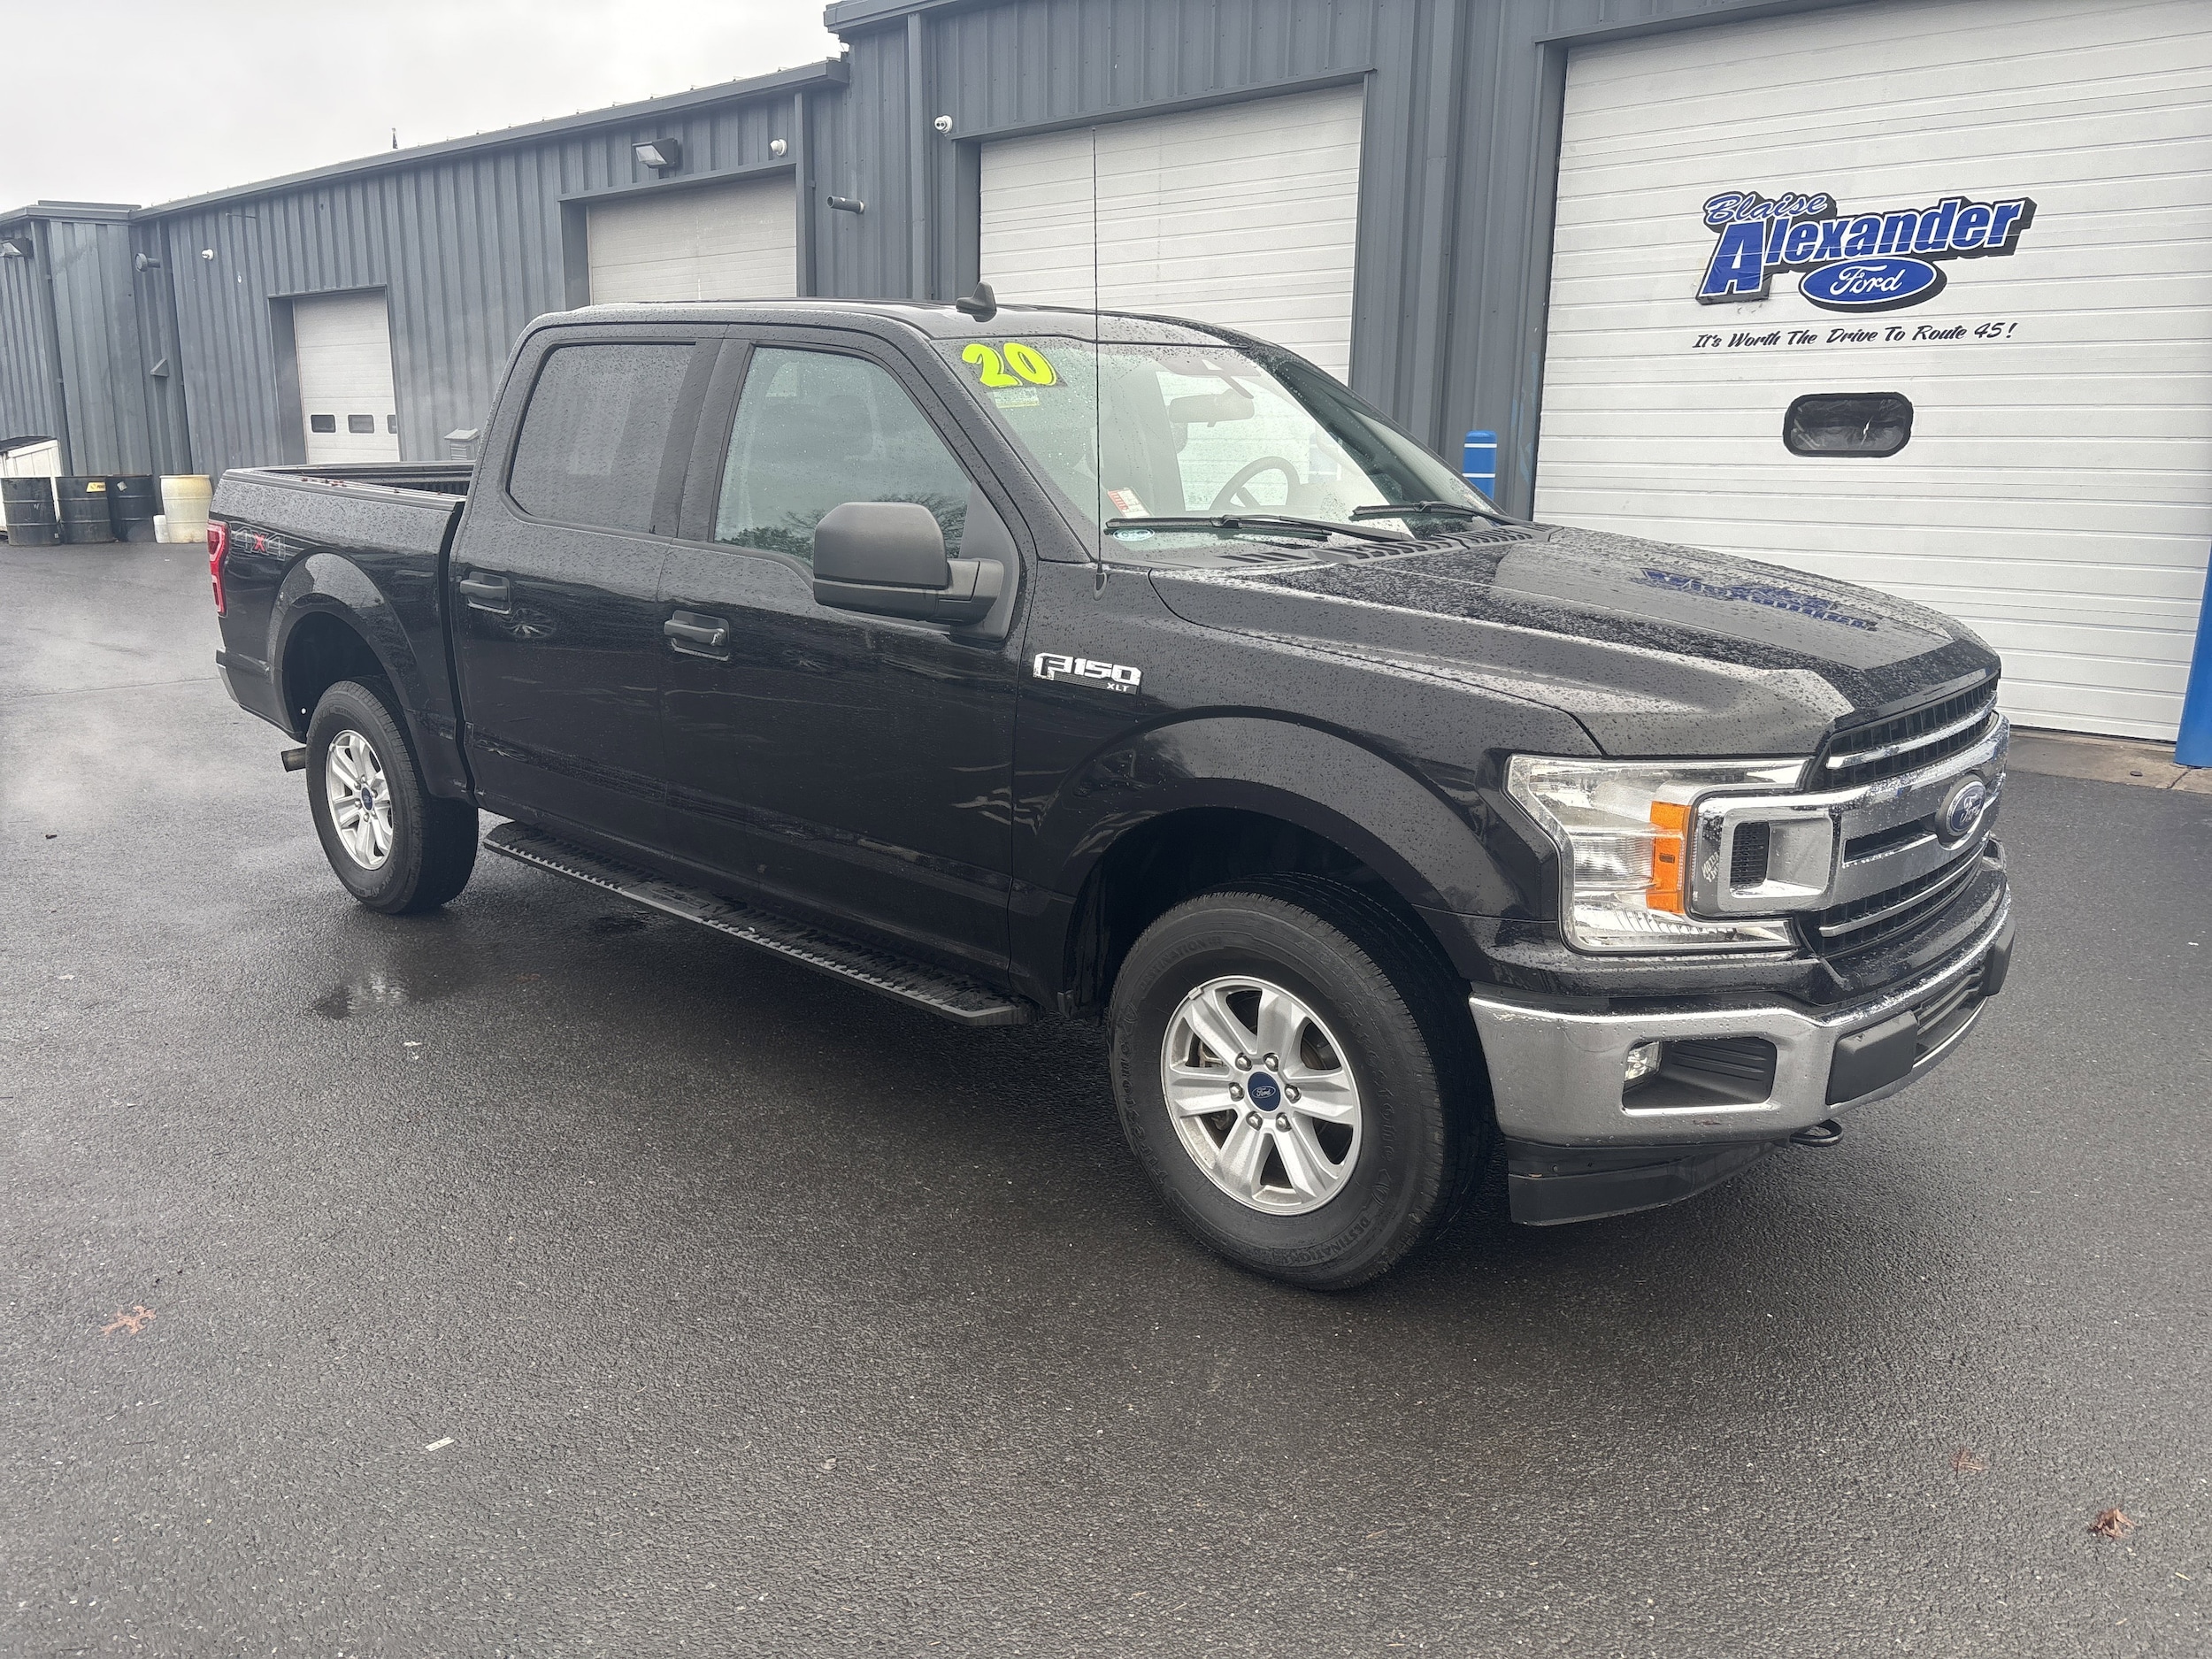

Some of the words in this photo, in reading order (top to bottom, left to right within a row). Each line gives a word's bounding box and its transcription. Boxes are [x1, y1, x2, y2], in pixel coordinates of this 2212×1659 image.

[1704, 192, 1829, 226] Blaise
[1697, 196, 2026, 298] Alexander
[1830, 265, 1906, 296] Ford
[1692, 334, 1723, 349] It's
[1727, 330, 1781, 348] Worth
[1787, 329, 1818, 346] The
[1826, 328, 1878, 343] Drive
[1885, 326, 1906, 342] To
[1911, 325, 1968, 341] Route
[961, 342, 1058, 388] 20
[1106, 682, 1130, 693] XLT
